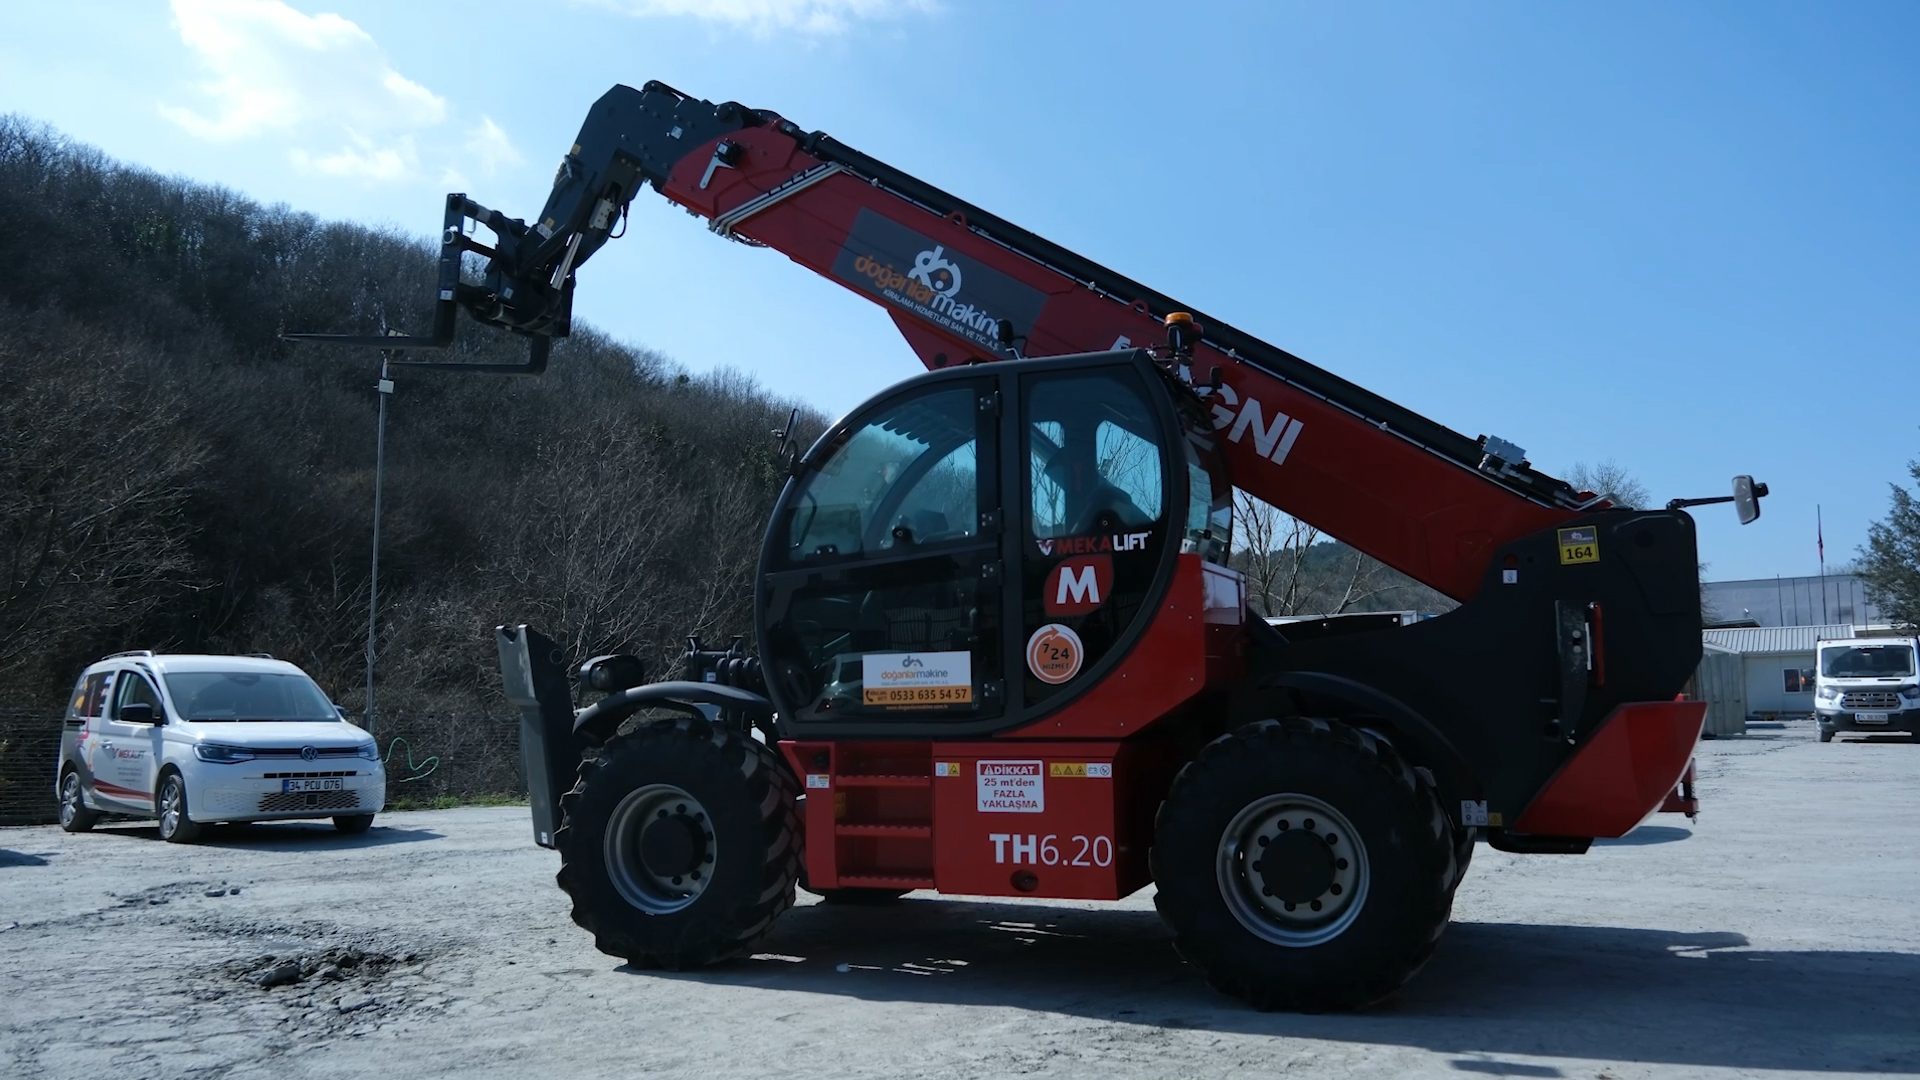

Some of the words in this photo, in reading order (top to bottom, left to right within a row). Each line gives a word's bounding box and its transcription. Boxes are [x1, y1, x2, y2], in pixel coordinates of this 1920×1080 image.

[914, 302, 951, 327] HİZMETLERİ
[966, 328, 975, 338] VE
[1056, 533, 1148, 553] MEKALIFT
[1566, 547, 1593, 560] 164
[1056, 565, 1100, 604] M
[890, 690, 914, 701] 0533
[918, 689, 936, 700] 635
[939, 689, 952, 699] 54
[955, 688, 968, 699] 57
[996, 764, 1035, 775] DİKKAT
[289, 781, 301, 791] 34
[304, 780, 321, 790] PCU
[324, 780, 340, 790] 076
[984, 778, 997, 787] 25
[1000, 778, 1035, 787] mt'den
[993, 790, 1025, 798] FAZLA
[982, 800, 1038, 810] YAKLAŞMA
[989, 833, 1113, 867] TH6.20
